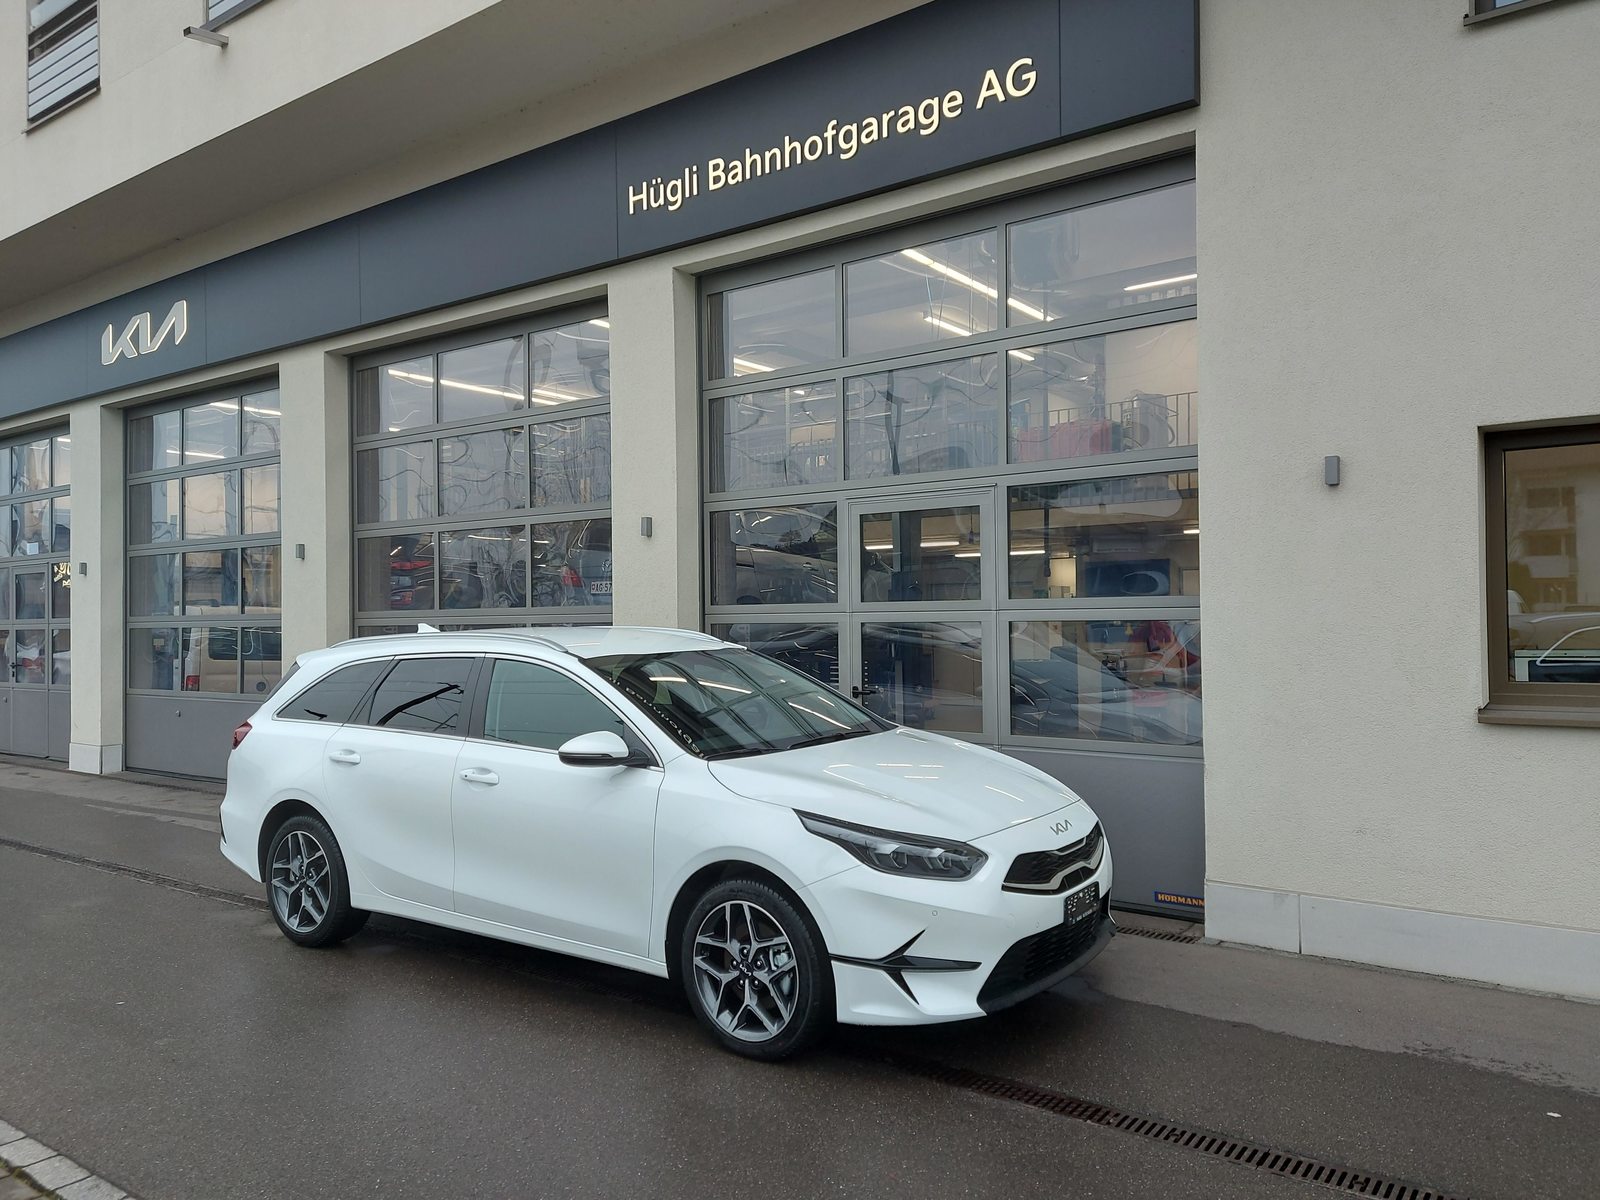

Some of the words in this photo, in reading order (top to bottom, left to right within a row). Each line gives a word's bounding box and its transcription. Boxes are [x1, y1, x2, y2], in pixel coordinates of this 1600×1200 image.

[628, 165, 698, 215] Hügli
[708, 89, 963, 191] Bahnhofgarage
[976, 57, 1037, 110] AG
[101, 299, 187, 366] KIA
[1050, 819, 1072, 835] KIA
